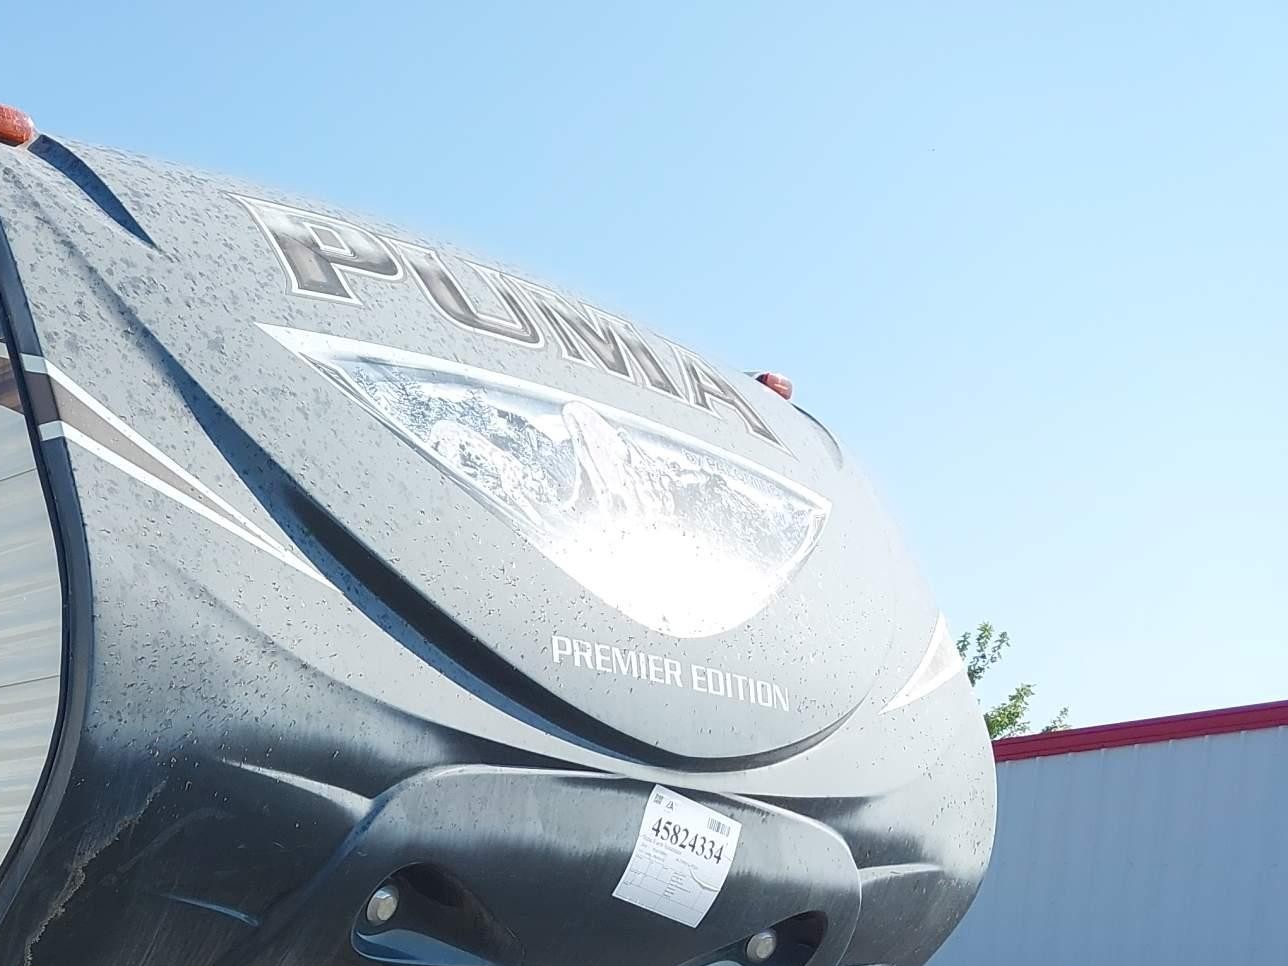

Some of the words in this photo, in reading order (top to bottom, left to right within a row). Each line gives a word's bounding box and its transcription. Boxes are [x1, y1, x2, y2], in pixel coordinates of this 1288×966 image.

[224, 190, 800, 461] PUMA
[551, 635, 683, 688] PREMIER
[691, 663, 790, 712] EDITION
[651, 816, 724, 865] 45824334
